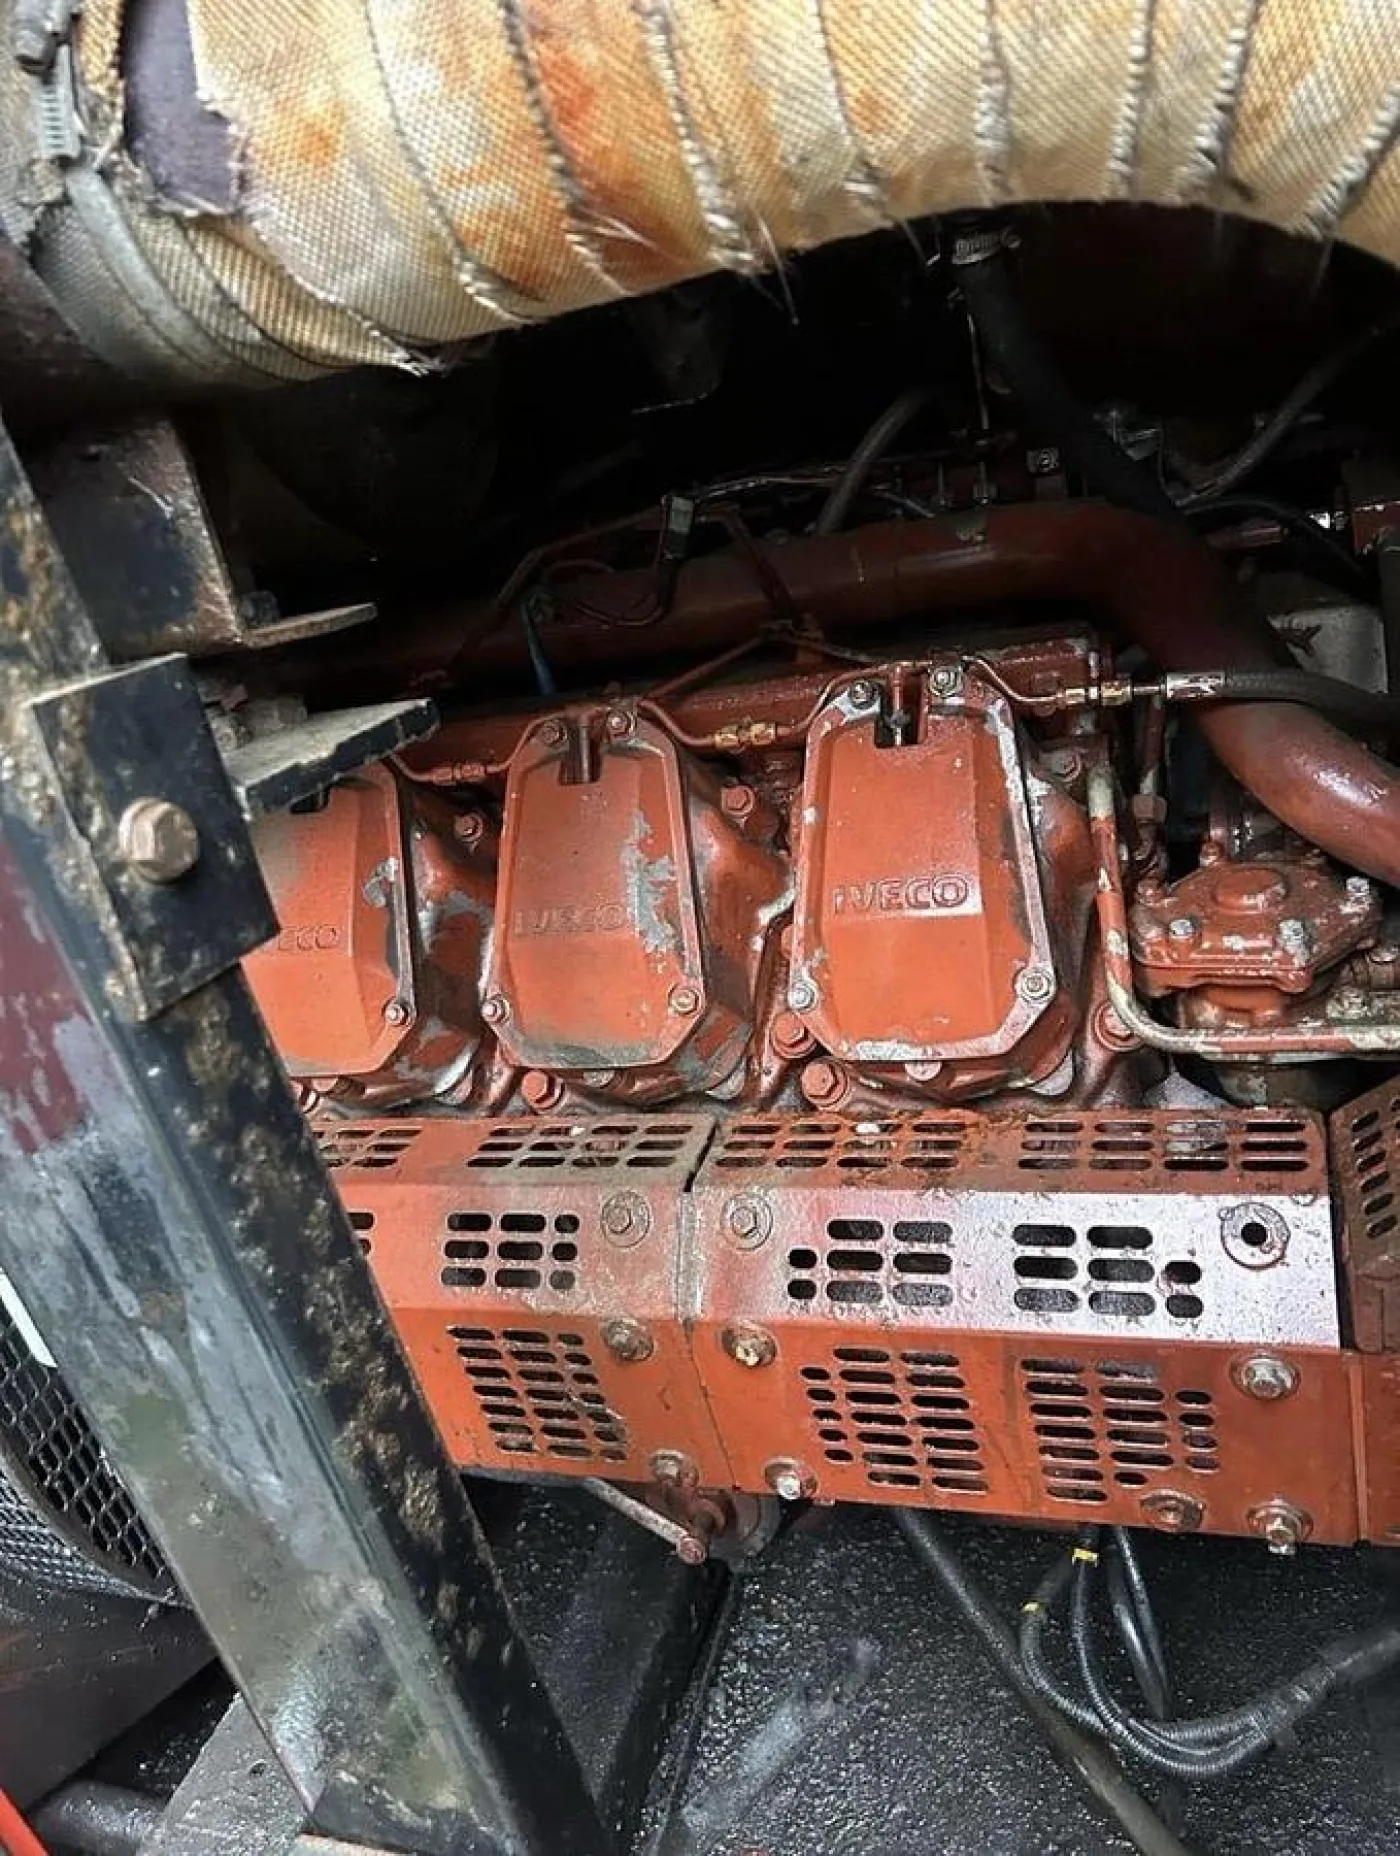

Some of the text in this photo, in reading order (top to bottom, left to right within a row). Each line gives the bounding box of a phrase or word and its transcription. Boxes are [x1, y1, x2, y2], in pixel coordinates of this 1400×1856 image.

[833, 872, 970, 914] IVECO
[514, 902, 625, 936] IVECO
[277, 923, 339, 952] ECO
